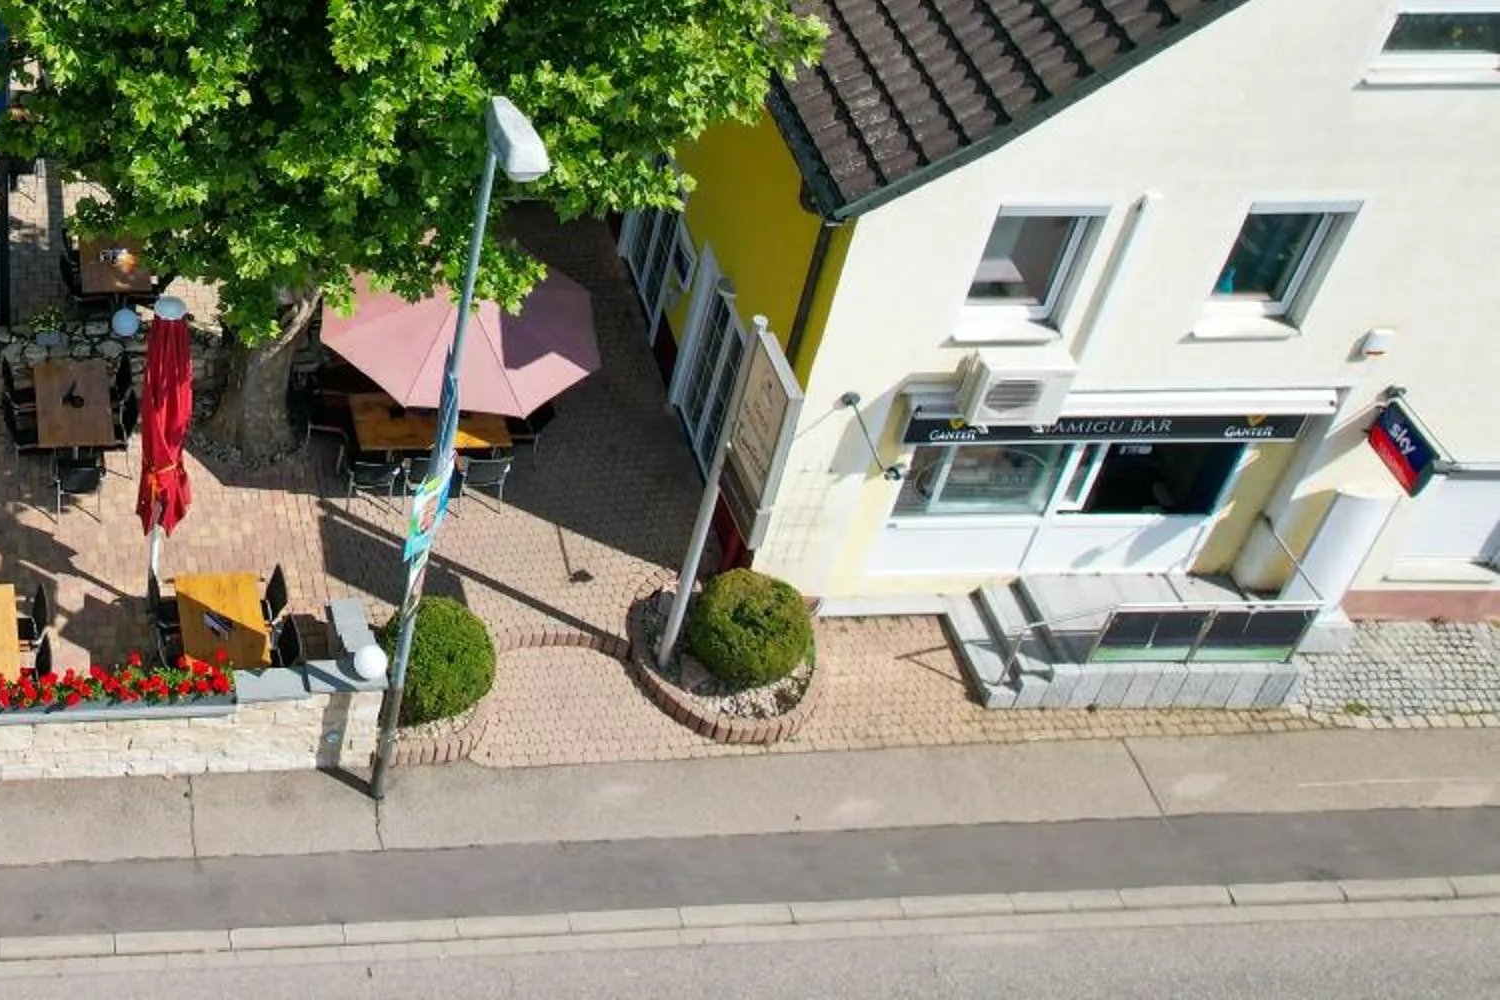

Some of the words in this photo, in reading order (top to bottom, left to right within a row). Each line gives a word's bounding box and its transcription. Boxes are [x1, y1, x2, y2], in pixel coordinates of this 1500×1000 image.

[1129, 418, 1173, 433] BAR
[1224, 425, 1274, 437] GANTER
[928, 429, 977, 441] GANTER
[1388, 423, 1417, 455] sky
